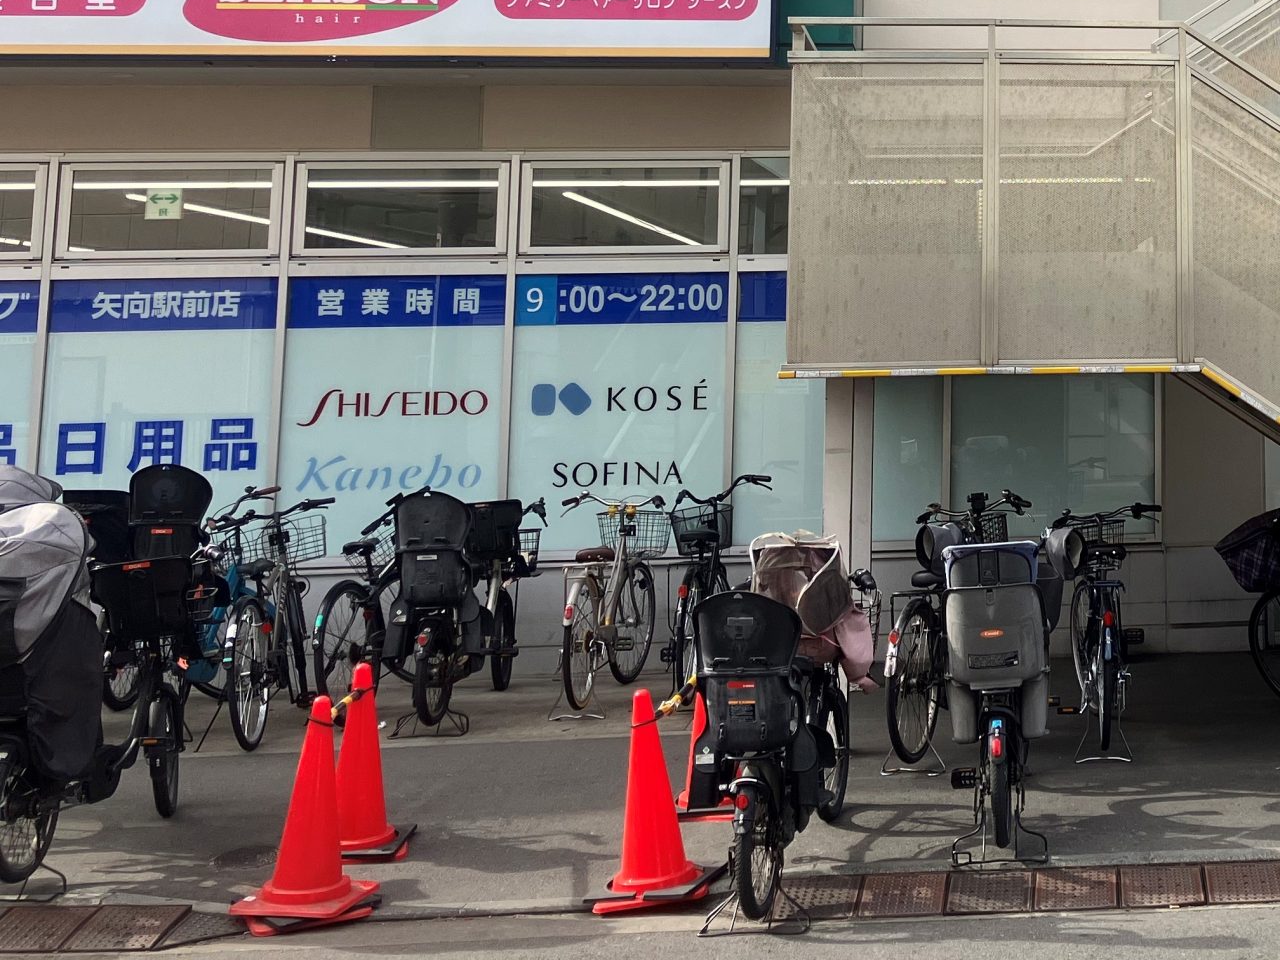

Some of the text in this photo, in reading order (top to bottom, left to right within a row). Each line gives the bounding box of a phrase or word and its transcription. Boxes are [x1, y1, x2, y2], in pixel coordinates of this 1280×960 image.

[295, 12, 361, 24] hair
[91, 290, 241, 321] 矢向駅前店
[317, 288, 480, 317] 営業時間
[297, 388, 488, 428] SHISEIDO
[299, 453, 483, 494] Kanebo
[553, 461, 683, 488] SOFINA
